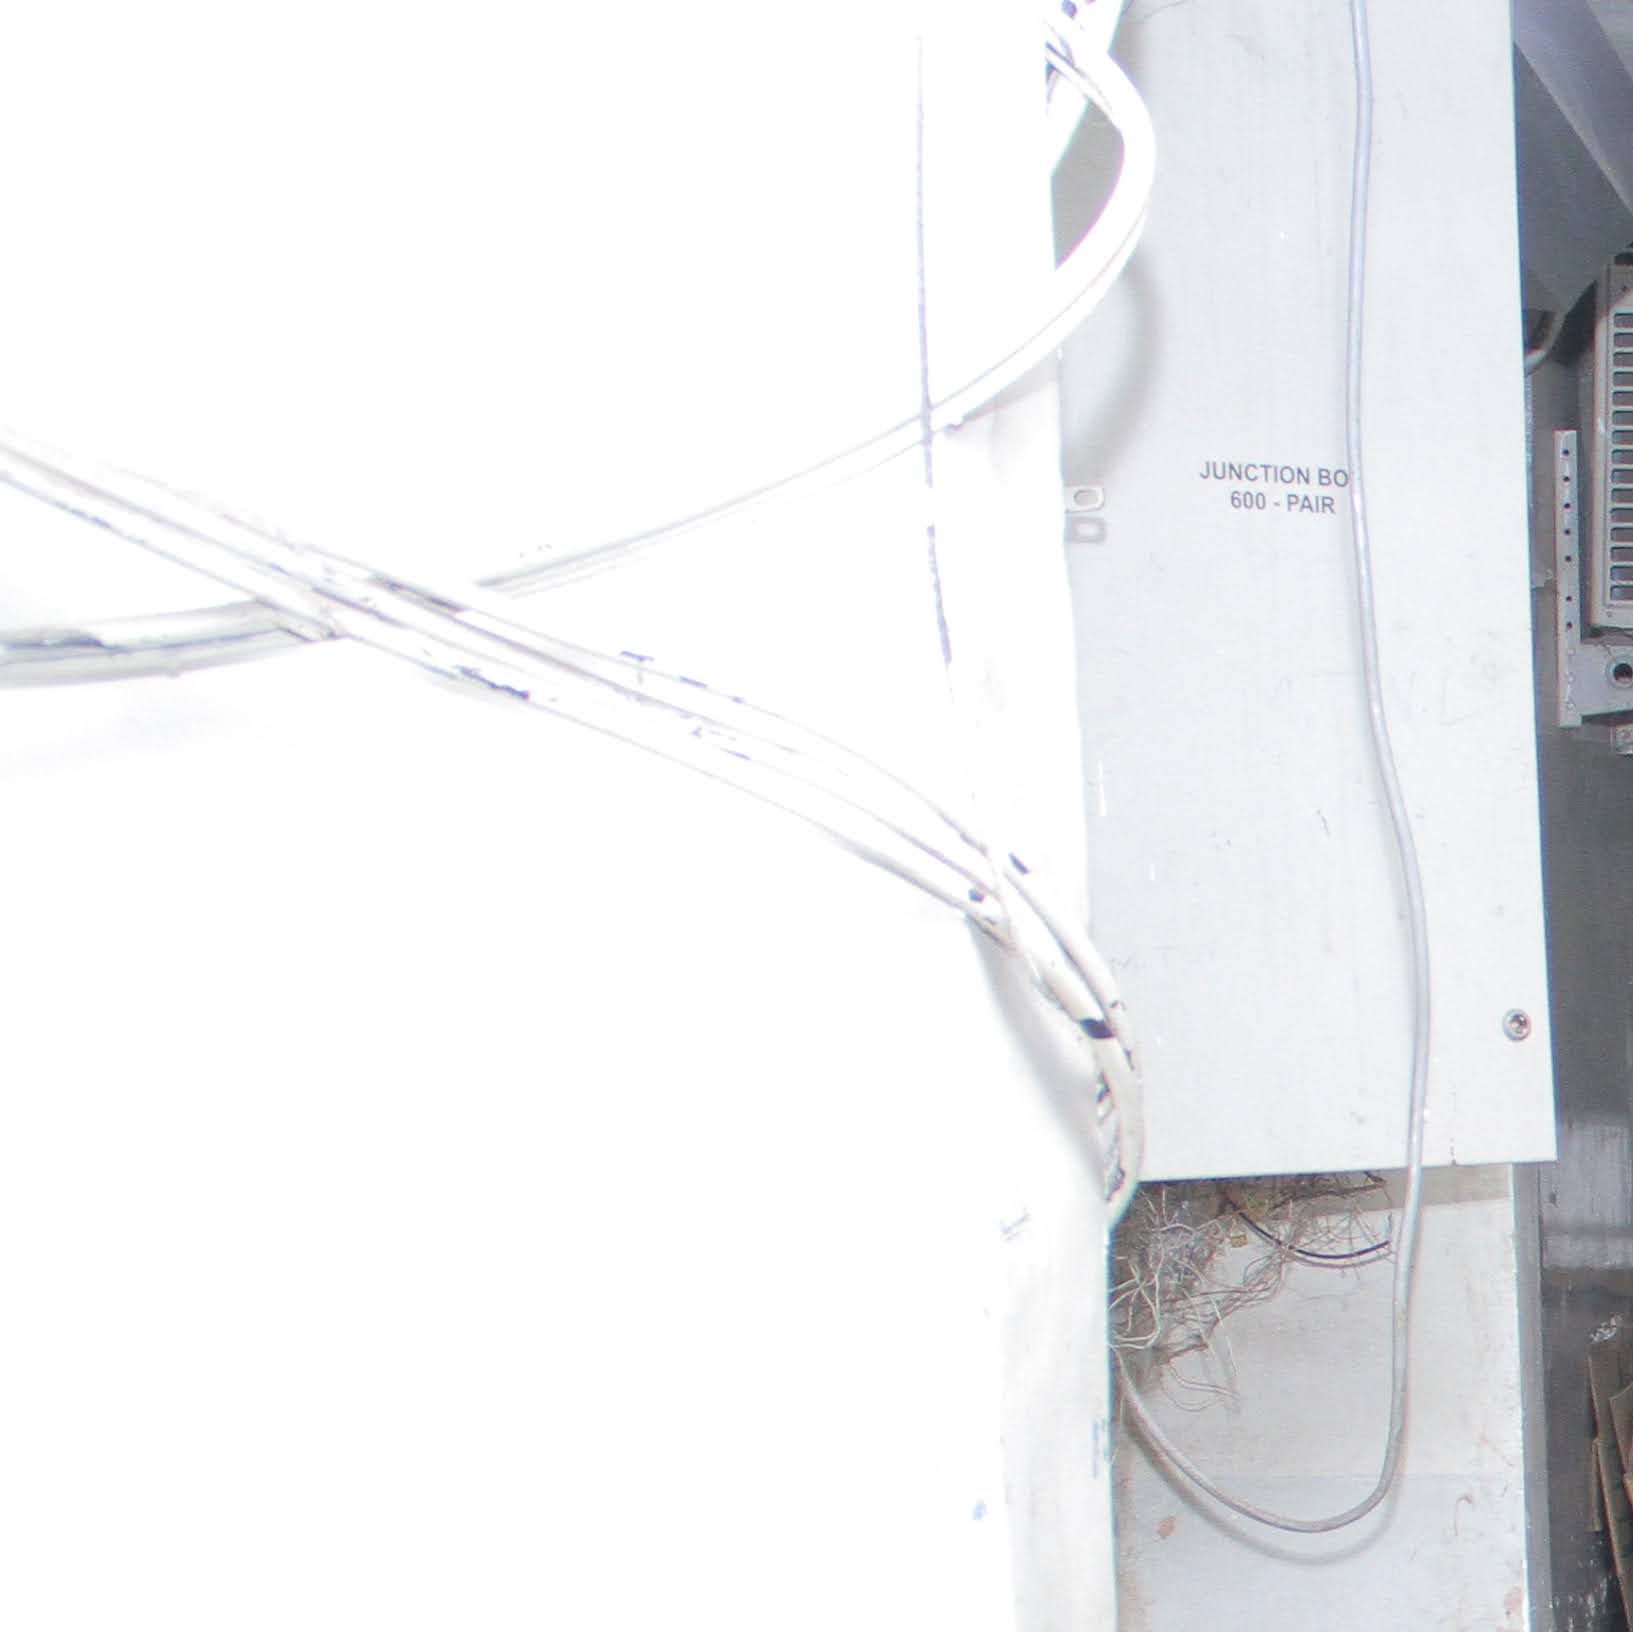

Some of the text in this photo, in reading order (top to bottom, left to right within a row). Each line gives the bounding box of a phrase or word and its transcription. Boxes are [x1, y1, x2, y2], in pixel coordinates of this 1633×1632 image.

[1200, 460, 1349, 488] JUNCTION BO
[1230, 490, 1266, 510] 600
[1287, 494, 1336, 514] PAIR
